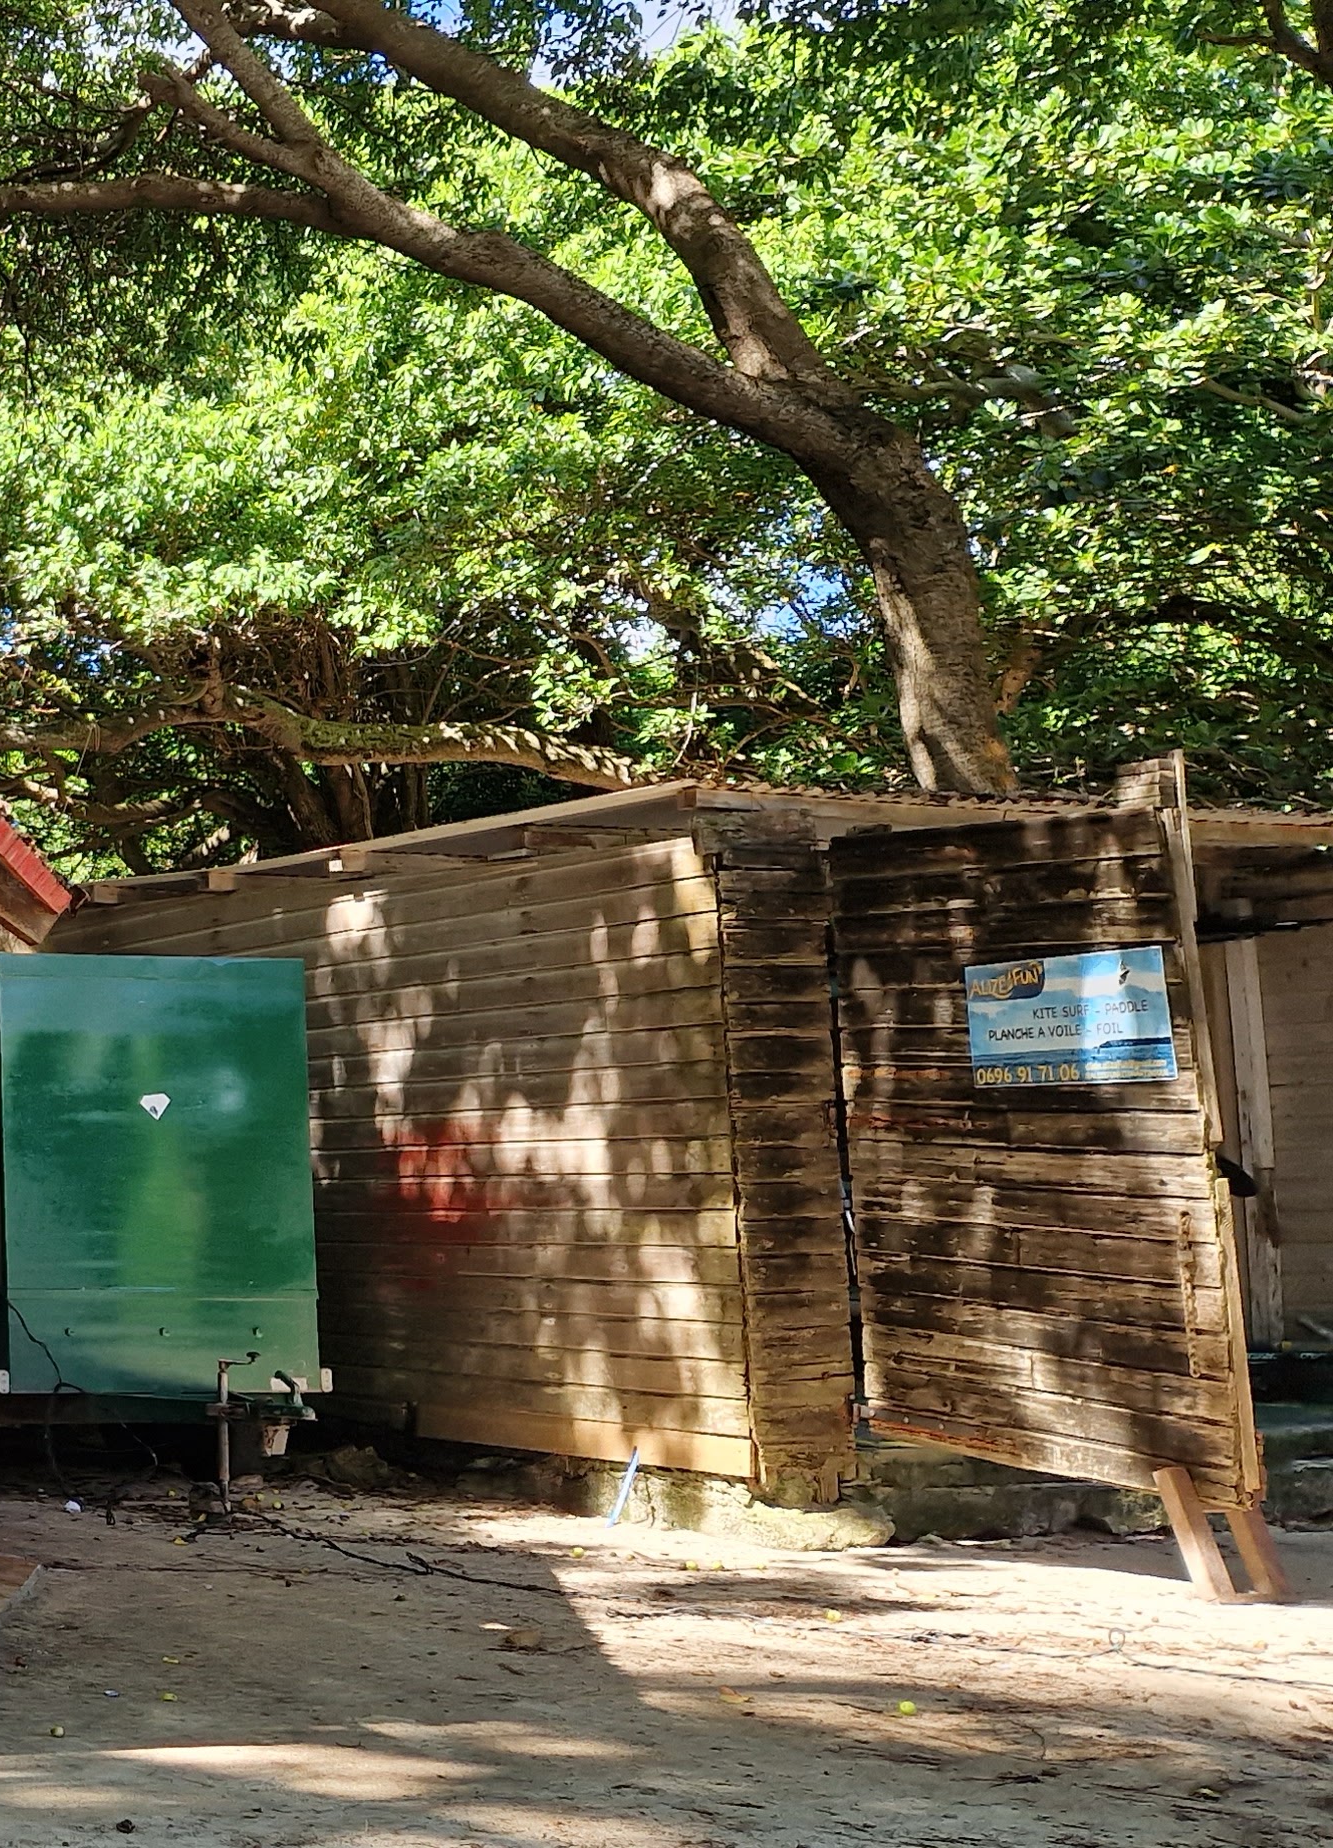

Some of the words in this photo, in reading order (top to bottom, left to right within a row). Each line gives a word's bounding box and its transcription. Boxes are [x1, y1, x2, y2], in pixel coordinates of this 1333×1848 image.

[1033, 1006, 1058, 1020] KITE
[1062, 1004, 1090, 1018] SURF
[1105, 1000, 1149, 1016] PADDLE
[989, 1027, 1035, 1042] PLANCHE
[1038, 1026, 1046, 1038] A
[1048, 1024, 1082, 1038] VOILE
[1096, 1022, 1124, 1035] FOIL
[976, 1067, 1012, 1085] 0696
[1017, 1066, 1033, 1083] 91
[1039, 1065, 1055, 1082] 71
[1060, 1064, 1079, 1081] 06
